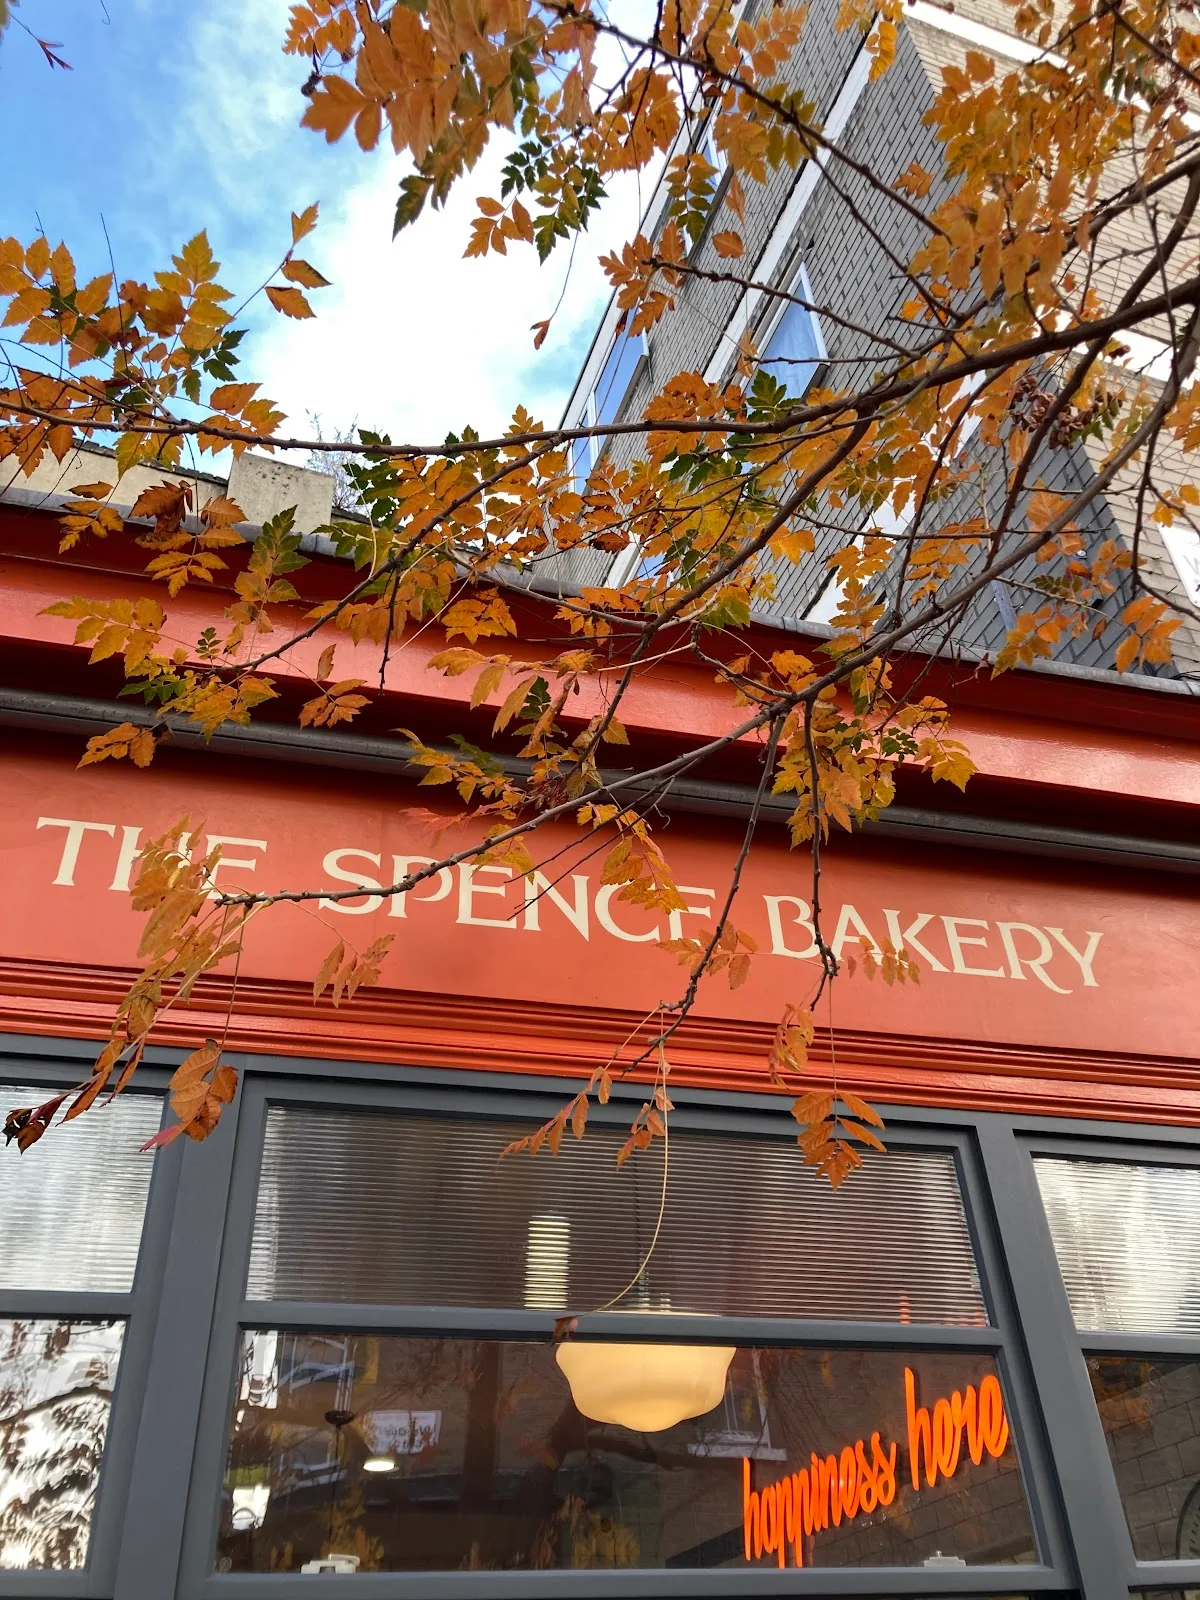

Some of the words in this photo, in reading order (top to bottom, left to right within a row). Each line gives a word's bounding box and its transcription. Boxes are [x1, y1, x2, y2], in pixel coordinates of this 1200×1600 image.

[318, 847, 721, 949] SPENCE
[762, 894, 1104, 994] BAKERY
[743, 1431, 897, 1569] happiness
[904, 1366, 1009, 1491] here
